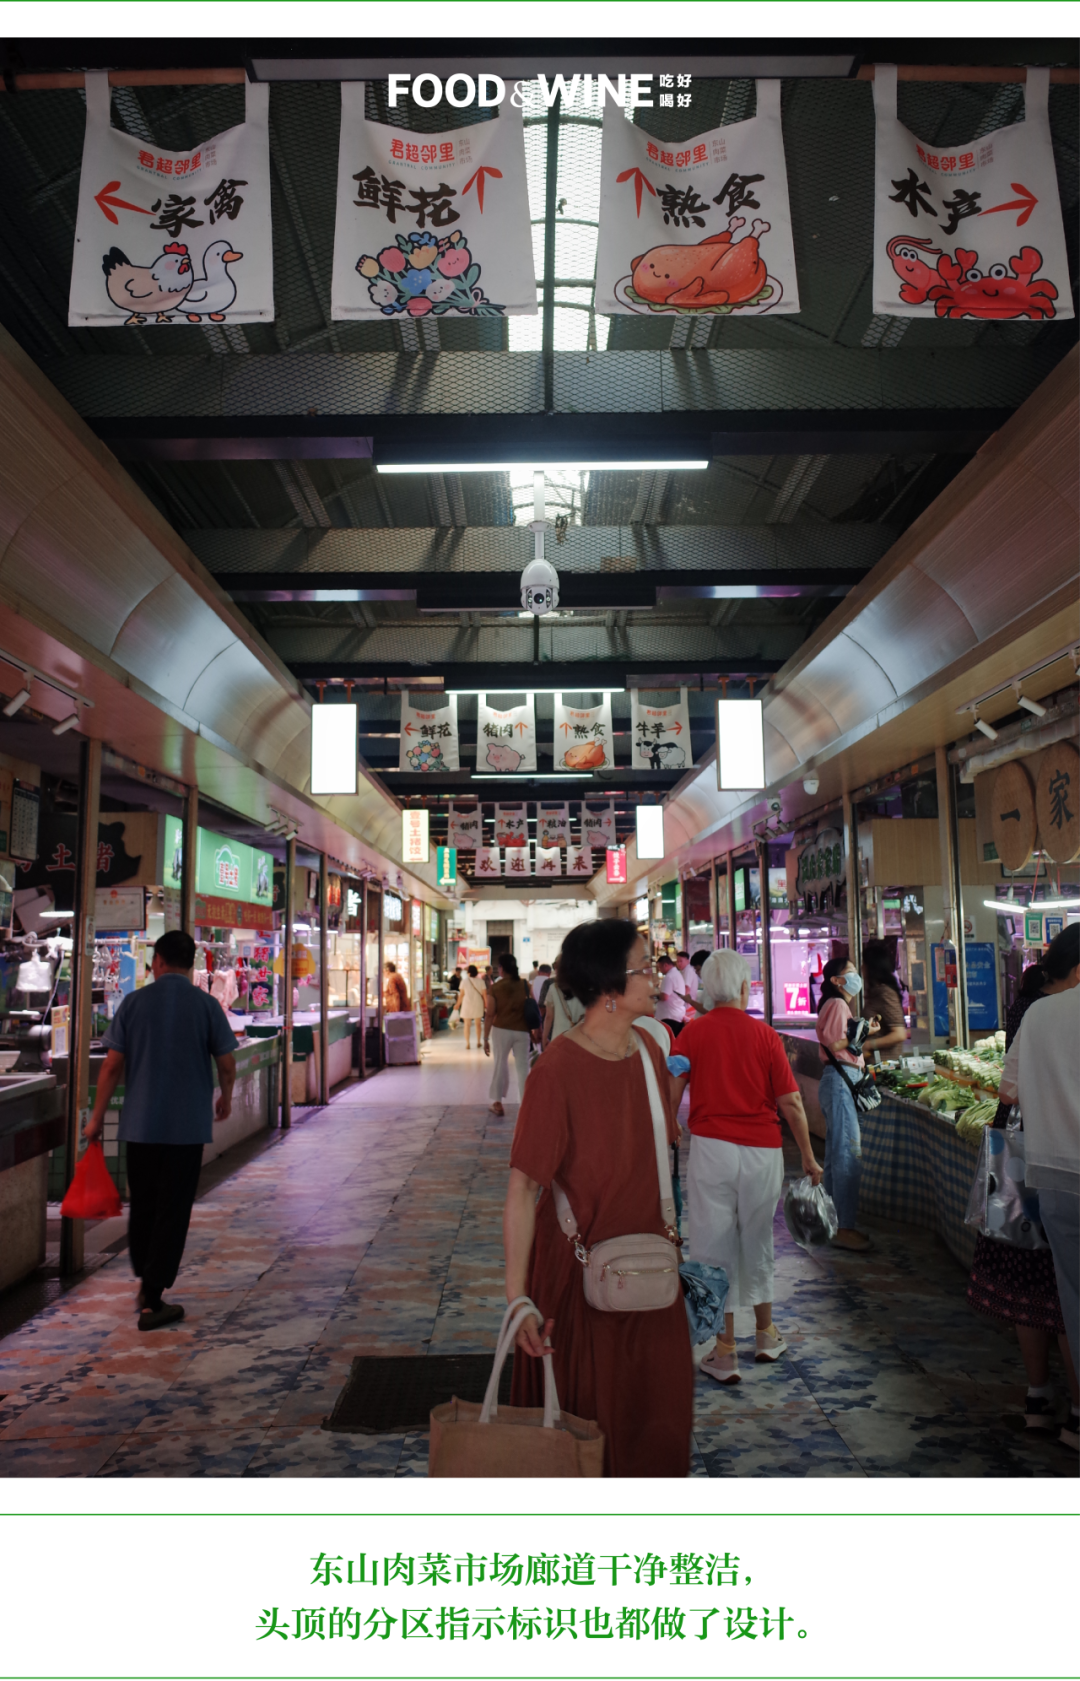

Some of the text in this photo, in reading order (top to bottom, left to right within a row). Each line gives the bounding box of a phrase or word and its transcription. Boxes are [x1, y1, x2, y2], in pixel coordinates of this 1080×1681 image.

[389, 138, 455, 163] 君超邻里
[712, 138, 726, 147] 东山
[138, 150, 202, 175] 君超邻里
[646, 141, 708, 167] 君超邻里
[421, 162, 455, 170] COMMUNITY
[675, 162, 709, 173] COMMUNITY
[352, 166, 461, 228] 鲜花
[656, 173, 765, 228] 熟食
[888, 168, 981, 235] 水产
[150, 179, 248, 237] 家禽
[420, 722, 452, 739] 鲜花
[483, 722, 514, 738] 猪肉
[573, 722, 606, 739] 熟食
[636, 721, 666, 738] 牛羊
[506, 819, 524, 829] 水产
